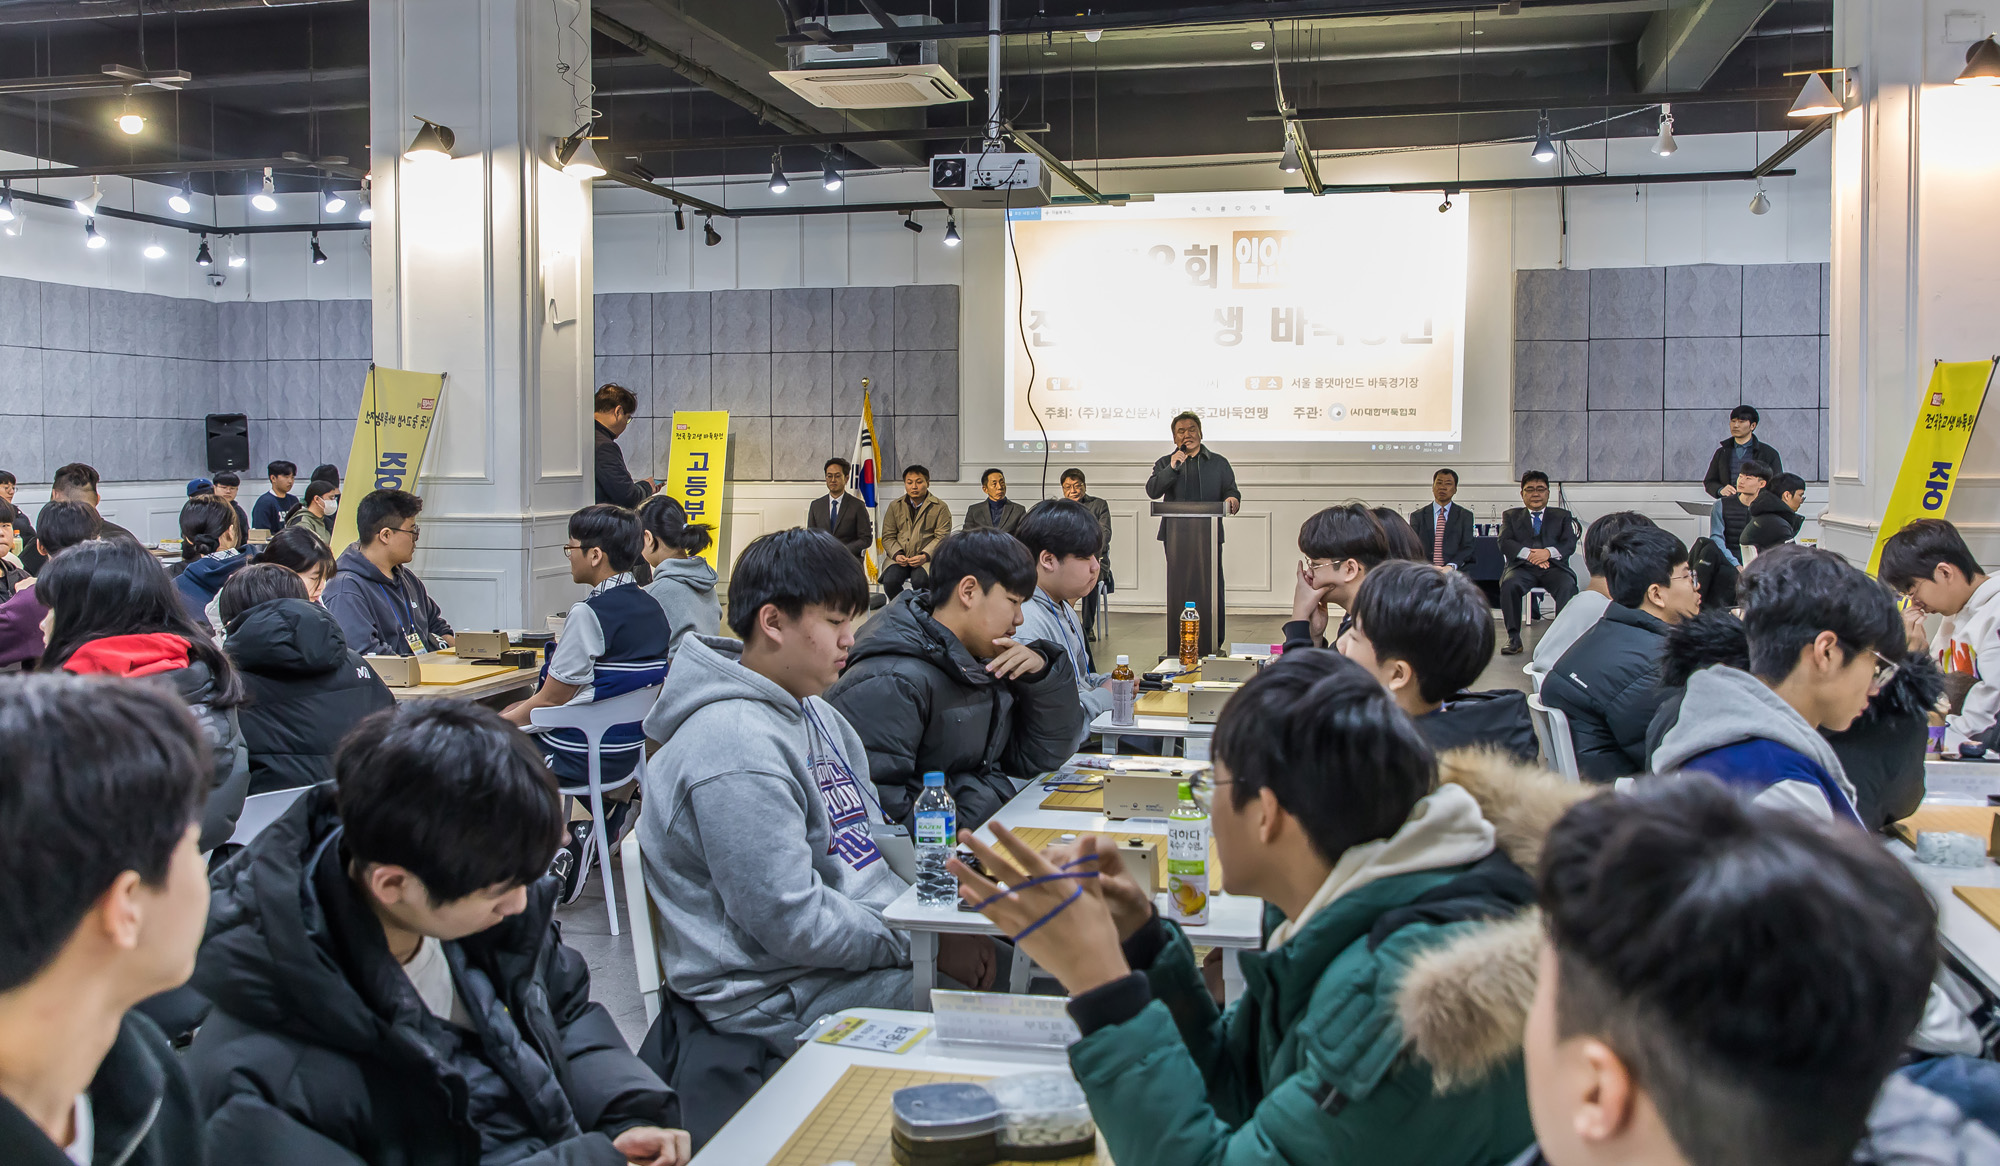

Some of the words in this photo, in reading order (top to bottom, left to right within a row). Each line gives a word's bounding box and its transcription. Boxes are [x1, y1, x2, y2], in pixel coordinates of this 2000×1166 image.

[1291, 377, 1311, 389] 서울
[1314, 377, 1365, 389] 올댓마인드
[1367, 377, 1419, 389] 바둑경기장
[1044, 406, 1073, 420] 주최:
[1078, 406, 1161, 420] (주)일요신문사
[1293, 406, 1323, 420] 주관:
[675, 432, 686, 440] 전국
[687, 432, 703, 440] 중고생
[703, 432, 724, 440] 바둑왕전
[684, 452, 709, 521] 고등부
[1922, 461, 1953, 511] 중
